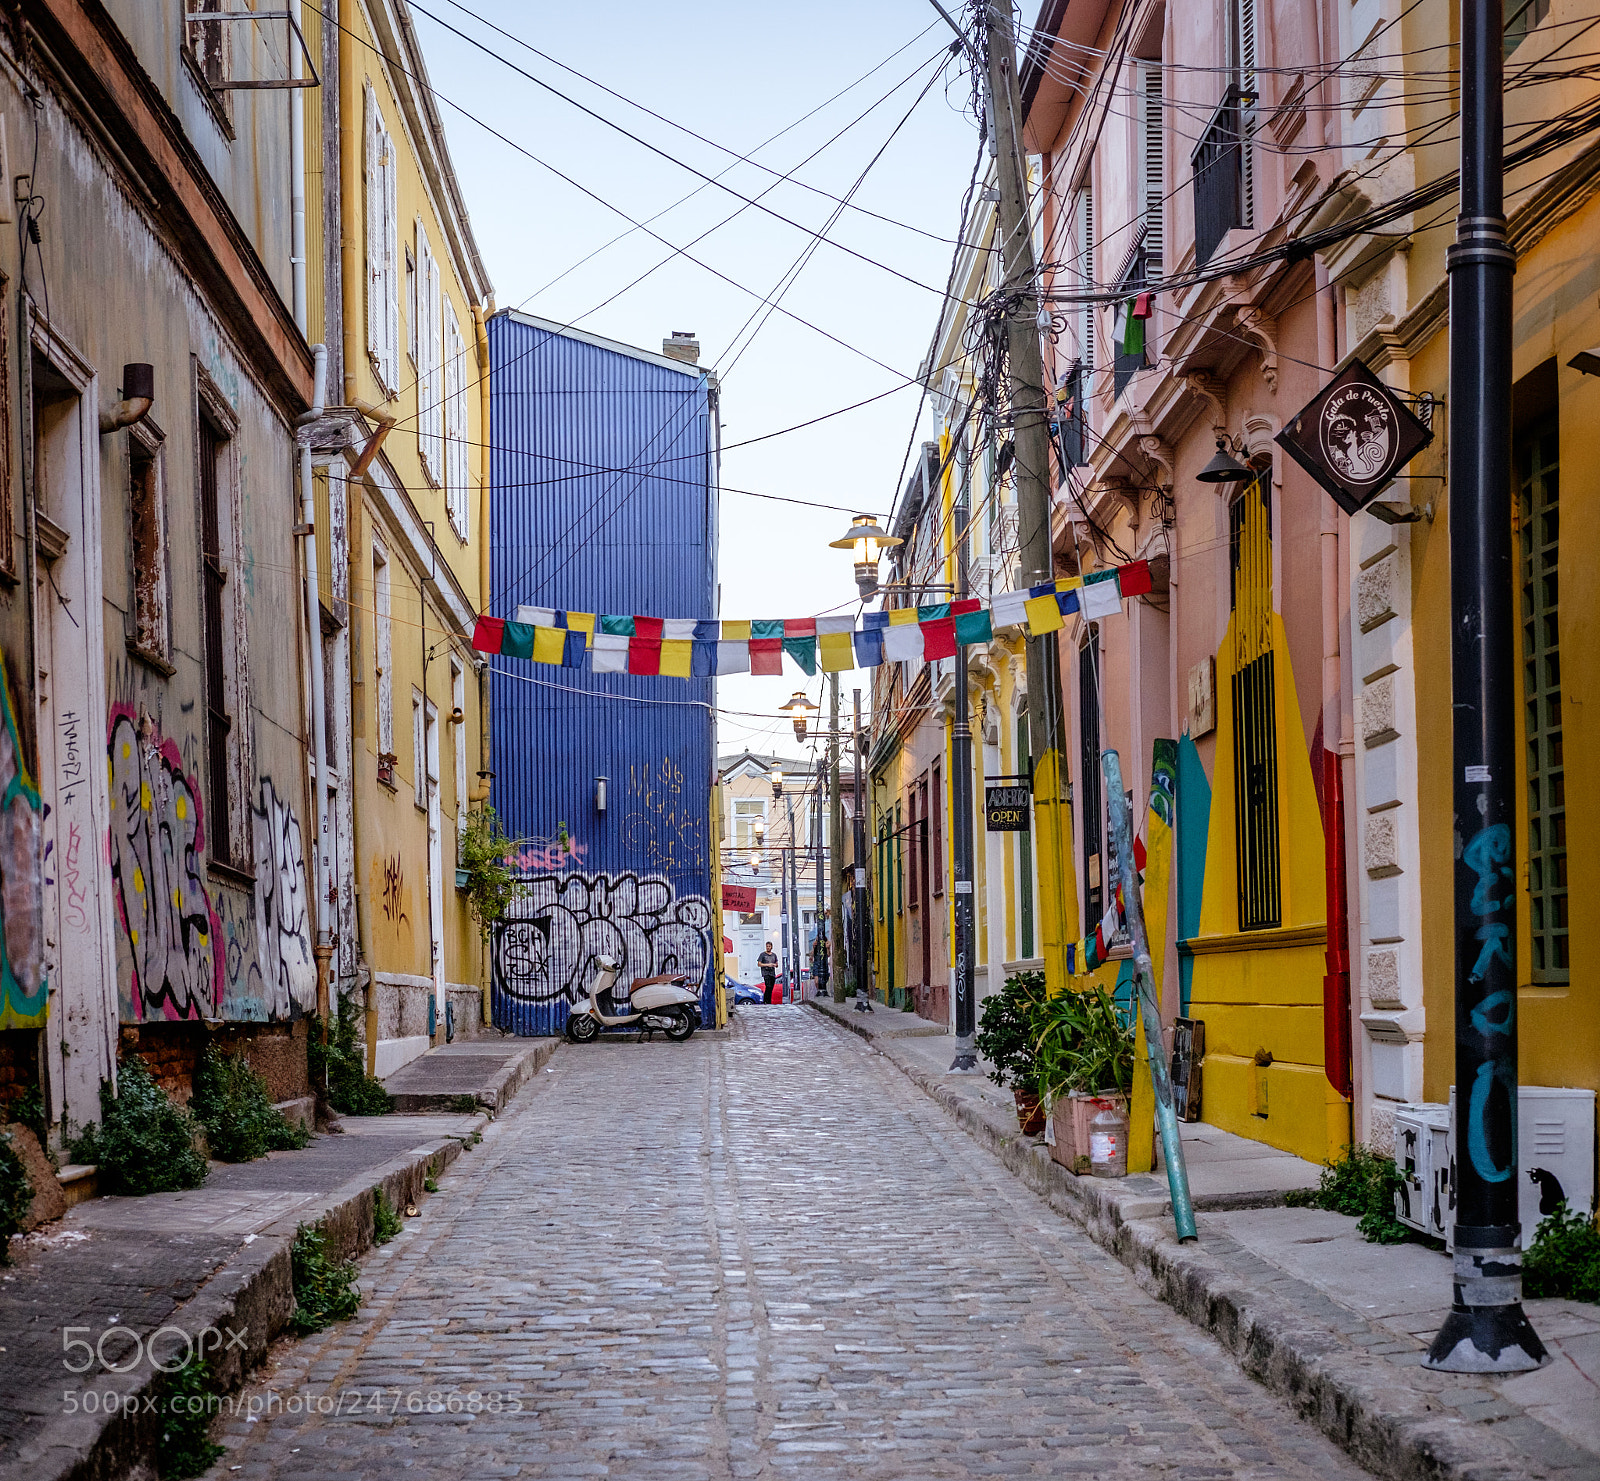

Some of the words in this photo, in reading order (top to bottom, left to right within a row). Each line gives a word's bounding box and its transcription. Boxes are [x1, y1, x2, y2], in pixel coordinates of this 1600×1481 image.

[1325, 398, 1345, 421] Gata
[1346, 389, 1359, 400] de
[1361, 390, 1390, 421] Puerto
[987, 788, 1028, 807] ABIERTO
[991, 811, 1021, 822] OPEN
